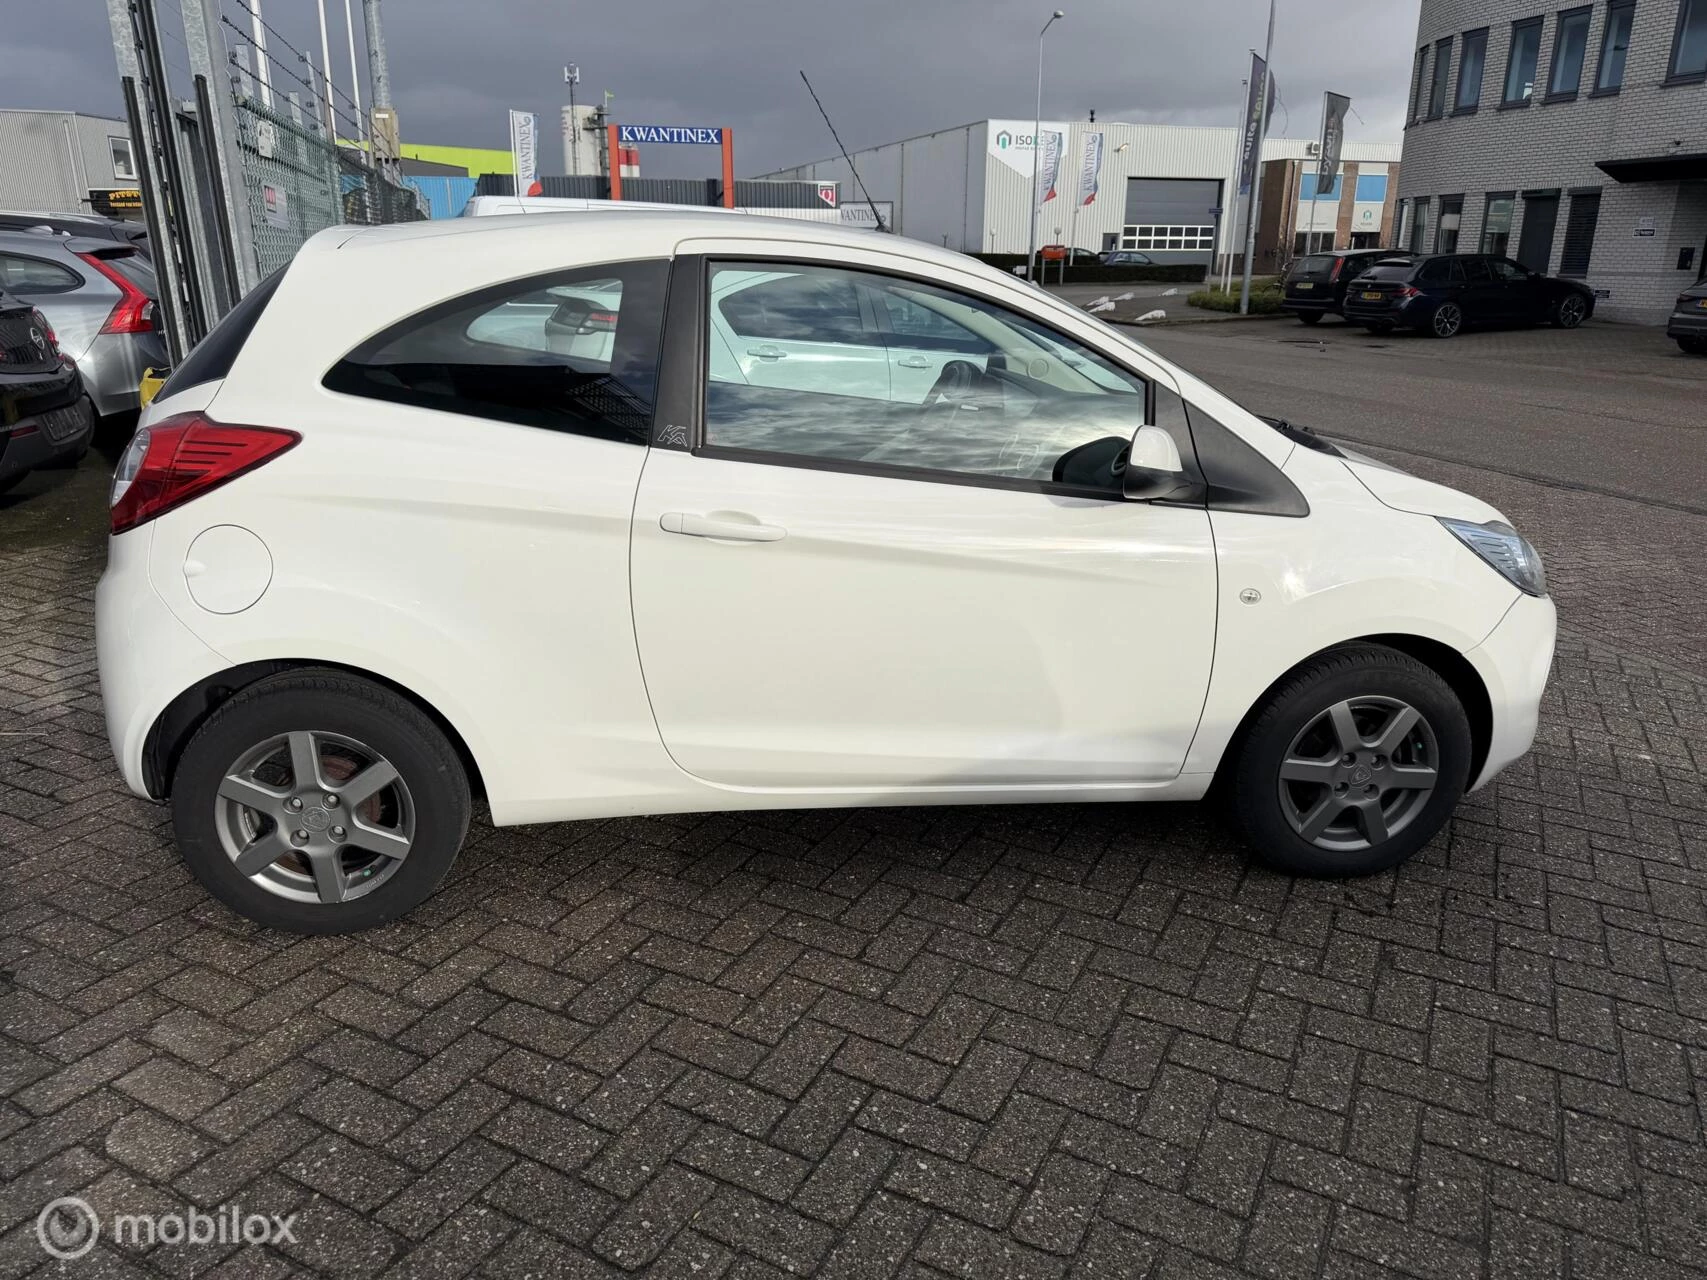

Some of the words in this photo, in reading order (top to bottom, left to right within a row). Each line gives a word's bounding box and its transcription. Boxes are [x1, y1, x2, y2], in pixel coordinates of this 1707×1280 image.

[621, 126, 720, 143] KWANTINEX
[519, 121, 533, 180] KWANTINEX
[109, 191, 142, 200] PITST
